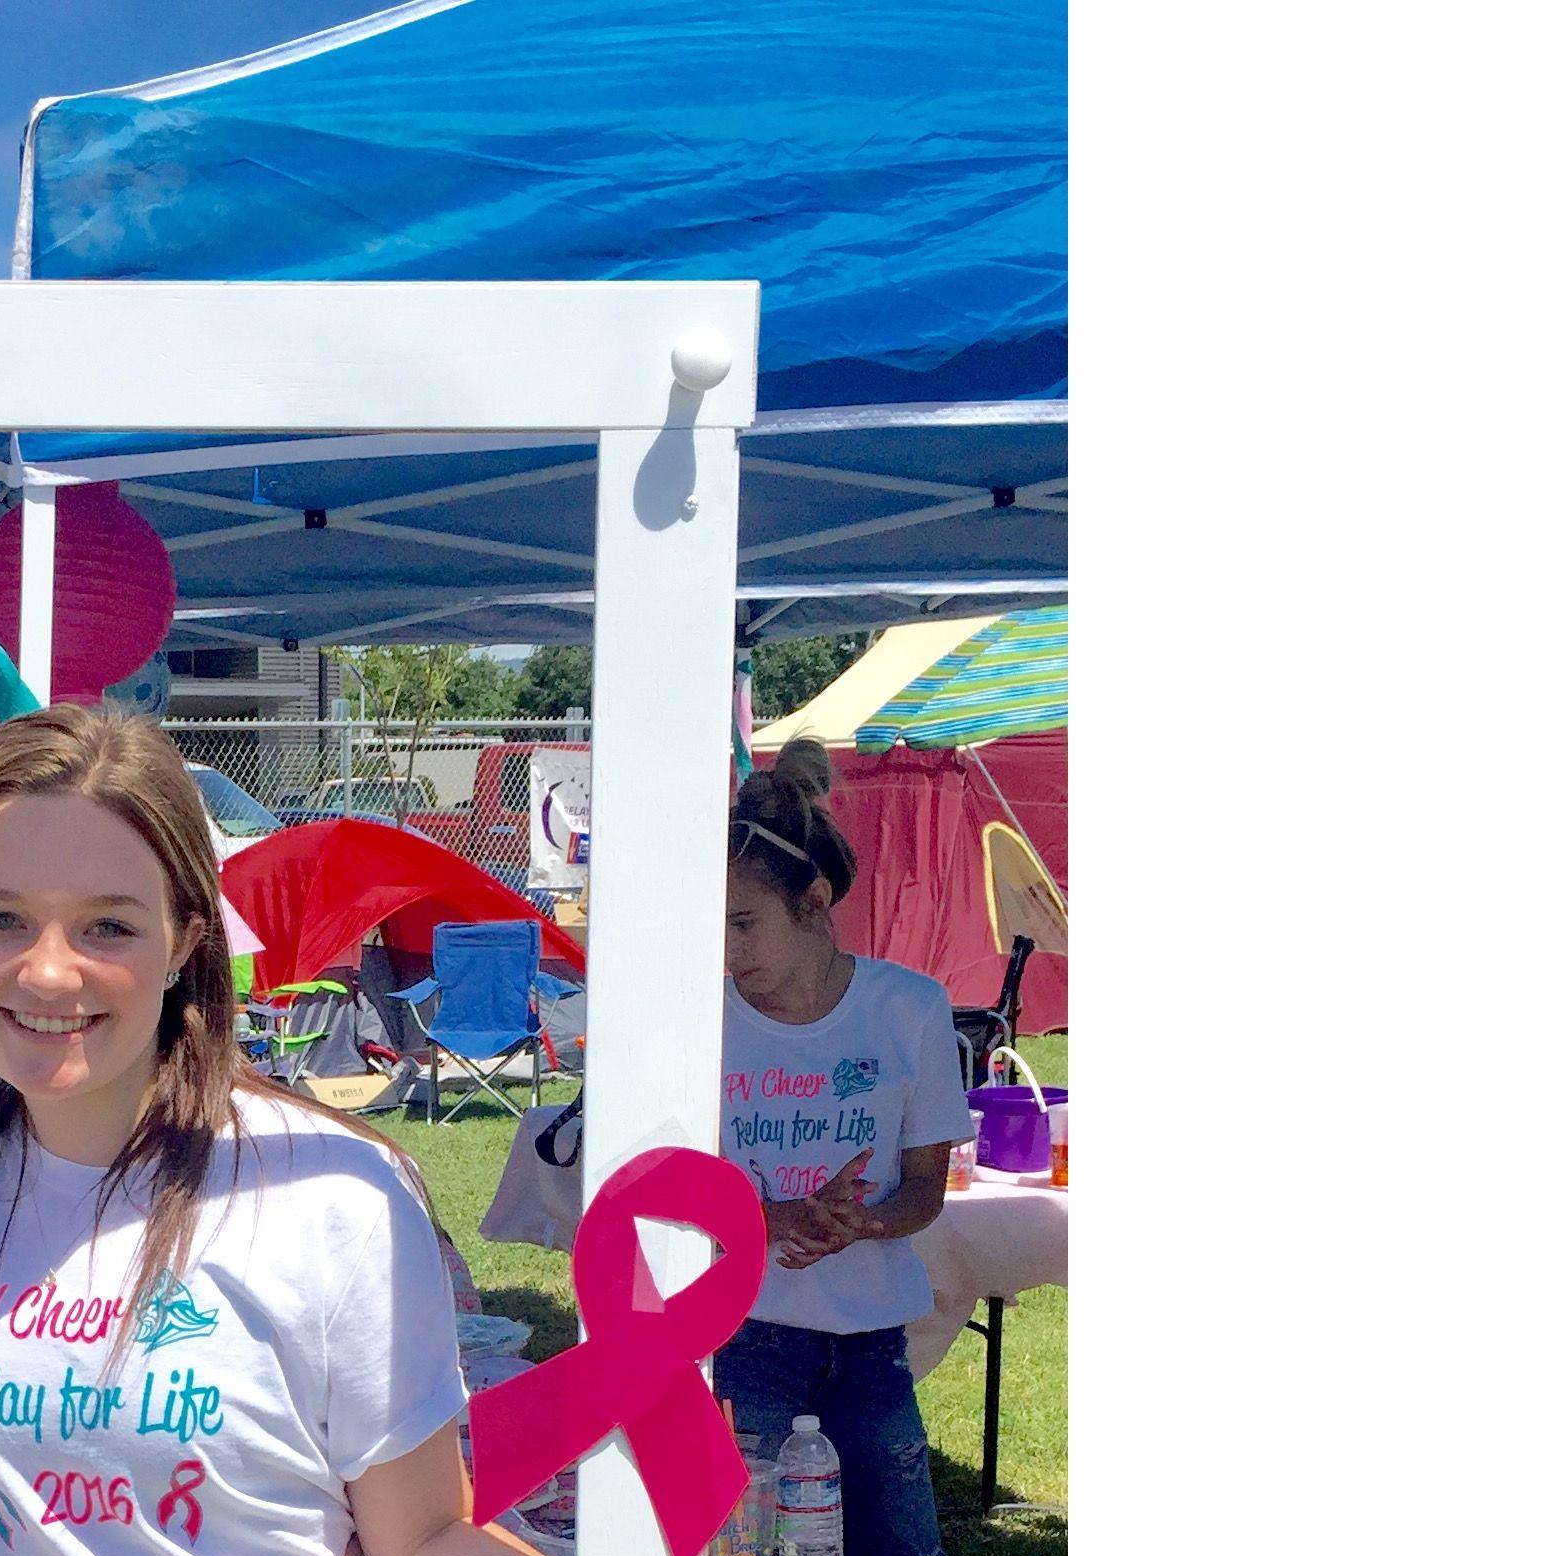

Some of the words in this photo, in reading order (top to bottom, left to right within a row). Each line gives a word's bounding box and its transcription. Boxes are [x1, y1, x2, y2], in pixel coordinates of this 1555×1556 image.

[725, 1070, 756, 1103] PV
[761, 1067, 828, 1099] Cheer
[731, 1112, 785, 1150] Relay
[792, 1110, 830, 1149] for
[834, 1107, 876, 1147] Life
[775, 1165, 829, 1197] 2016
[9, 1282, 126, 1344] Cheer
[60, 1366, 126, 1441] for
[136, 1368, 224, 1444] Life
[34, 1470, 135, 1526] 2016
